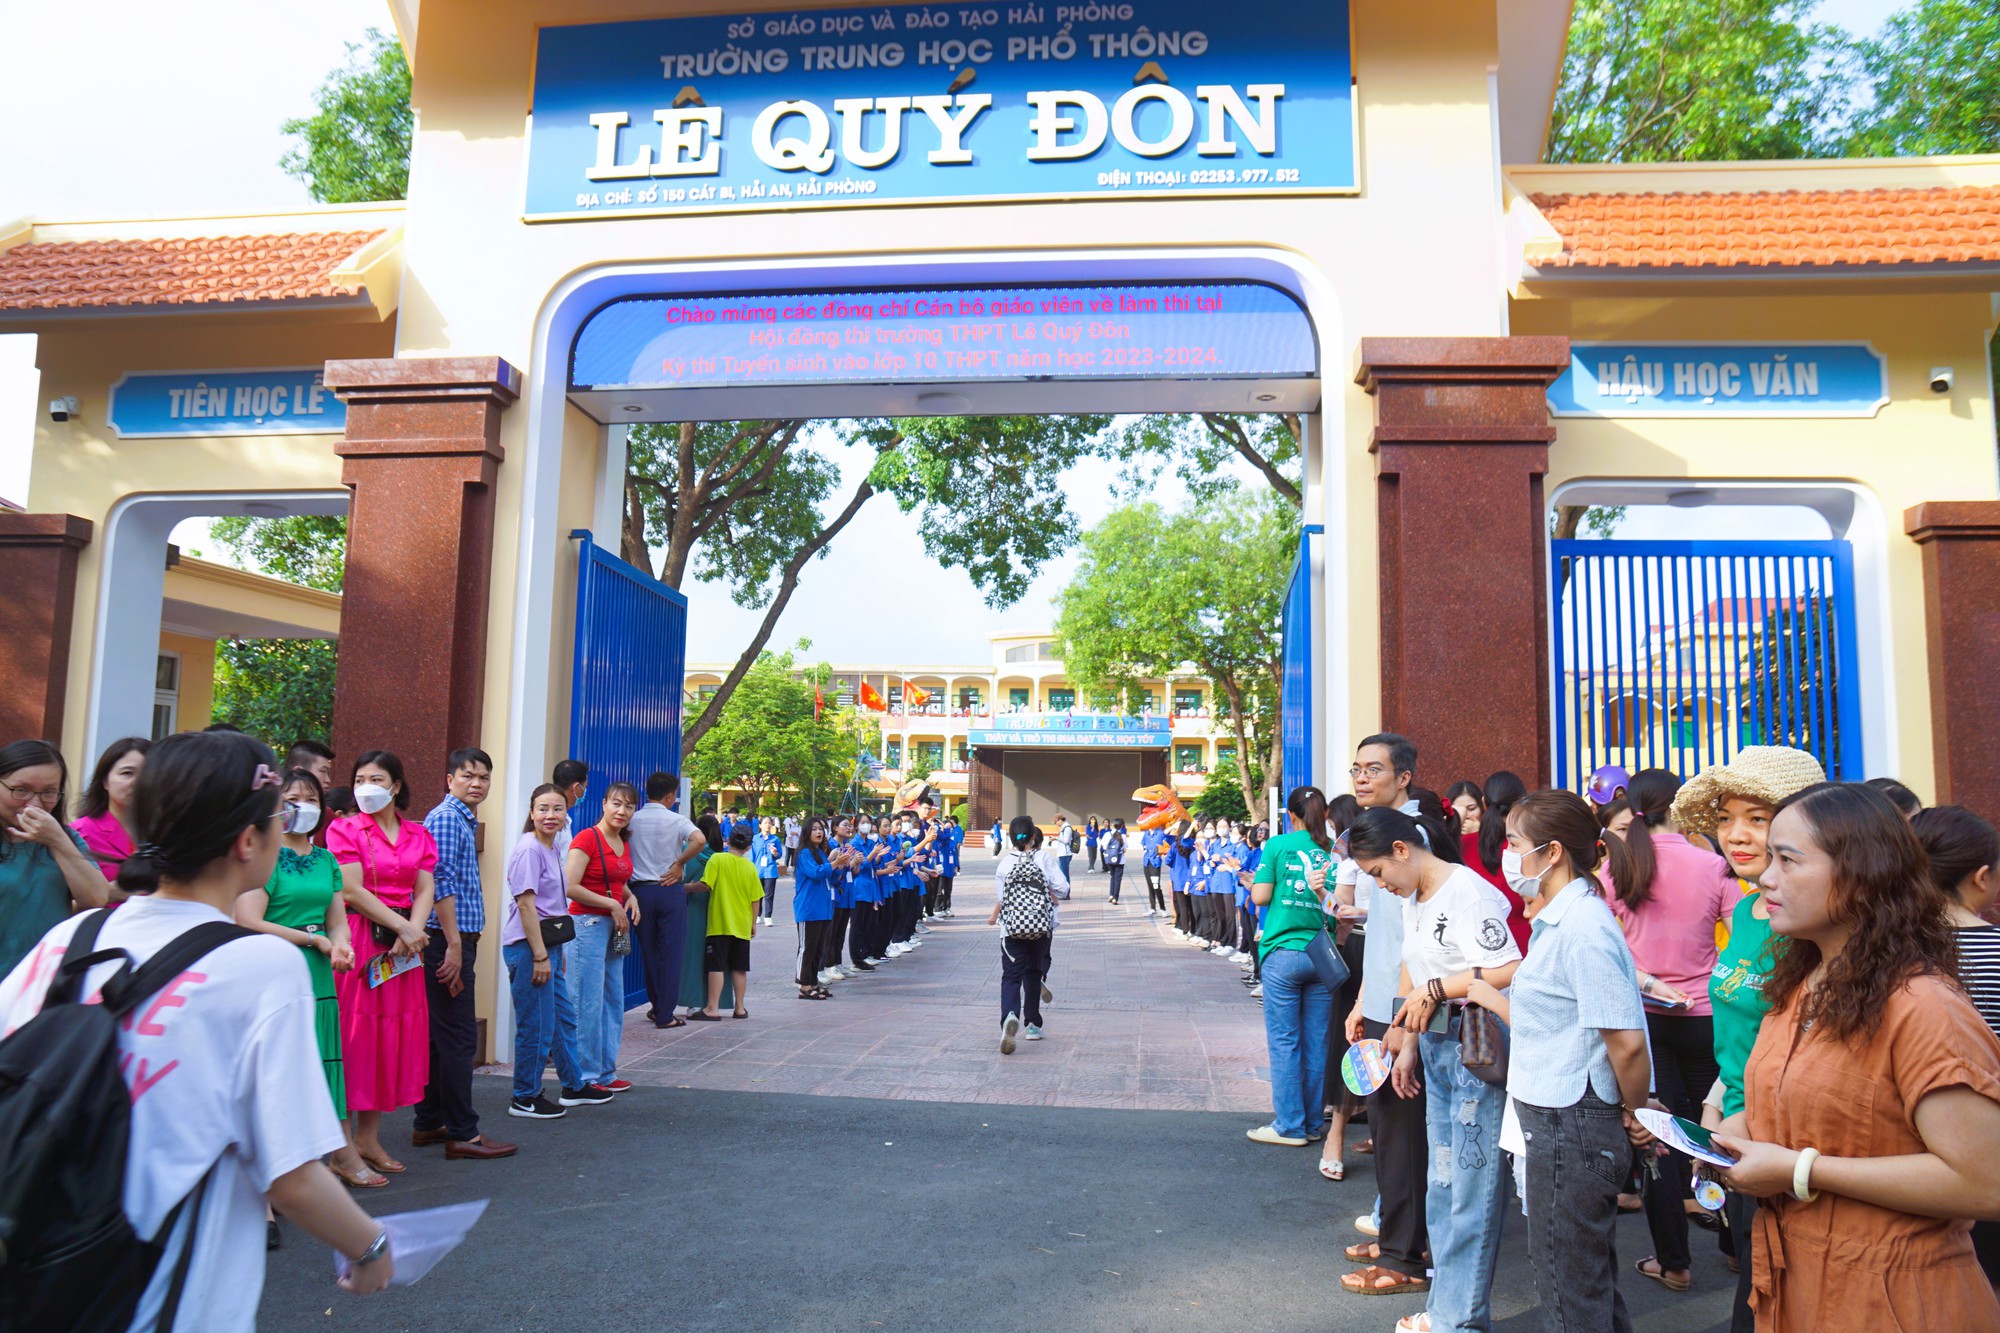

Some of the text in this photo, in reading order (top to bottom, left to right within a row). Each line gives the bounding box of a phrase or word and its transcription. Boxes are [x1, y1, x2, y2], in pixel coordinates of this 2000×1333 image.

[727, 3, 1134, 39] SỞ GIÁO DỤC VÀ ĐÀO TẠO HẢI PHÒNG
[660, 22, 1209, 80] TRƯỜNG TRUNG HỌC PHỔ THÔNG
[585, 61, 1286, 182] LÊ QUÝ ĐÔN
[576, 191, 600, 208] ĐỊA
[637, 182, 658, 204] SỐ
[663, 188, 685, 202] 150
[688, 183, 717, 201] CÁT
[720, 184, 736, 201] BI,
[740, 179, 766, 198] HẢI
[769, 182, 793, 199] AN,
[797, 177, 823, 196] HẢI
[825, 178, 877, 196] PHÒNG
[1097, 168, 1300, 188] ĐIỆN THOẠI: 02253.977.512
[666, 292, 1223, 324] Chào mừng các đồng chí Cán bộ giáo viên về làm thi tại
[750, 321, 1130, 349] Hội đồng thi trường THPT Lê Quý Đôn
[662, 356, 686, 379] Kỳ
[691, 356, 715, 374] thi
[785, 355, 828, 373] sinh
[833, 352, 869, 371] vào
[874, 352, 905, 373] lớp
[914, 352, 937, 369] 10
[943, 351, 1002, 368] THPT
[1007, 349, 1051, 367] năm
[1058, 349, 1095, 370] học
[1598, 354, 1819, 404] HẬU HỌC VĂN
[169, 373, 325, 424] TIÊN HỌC LỄ
